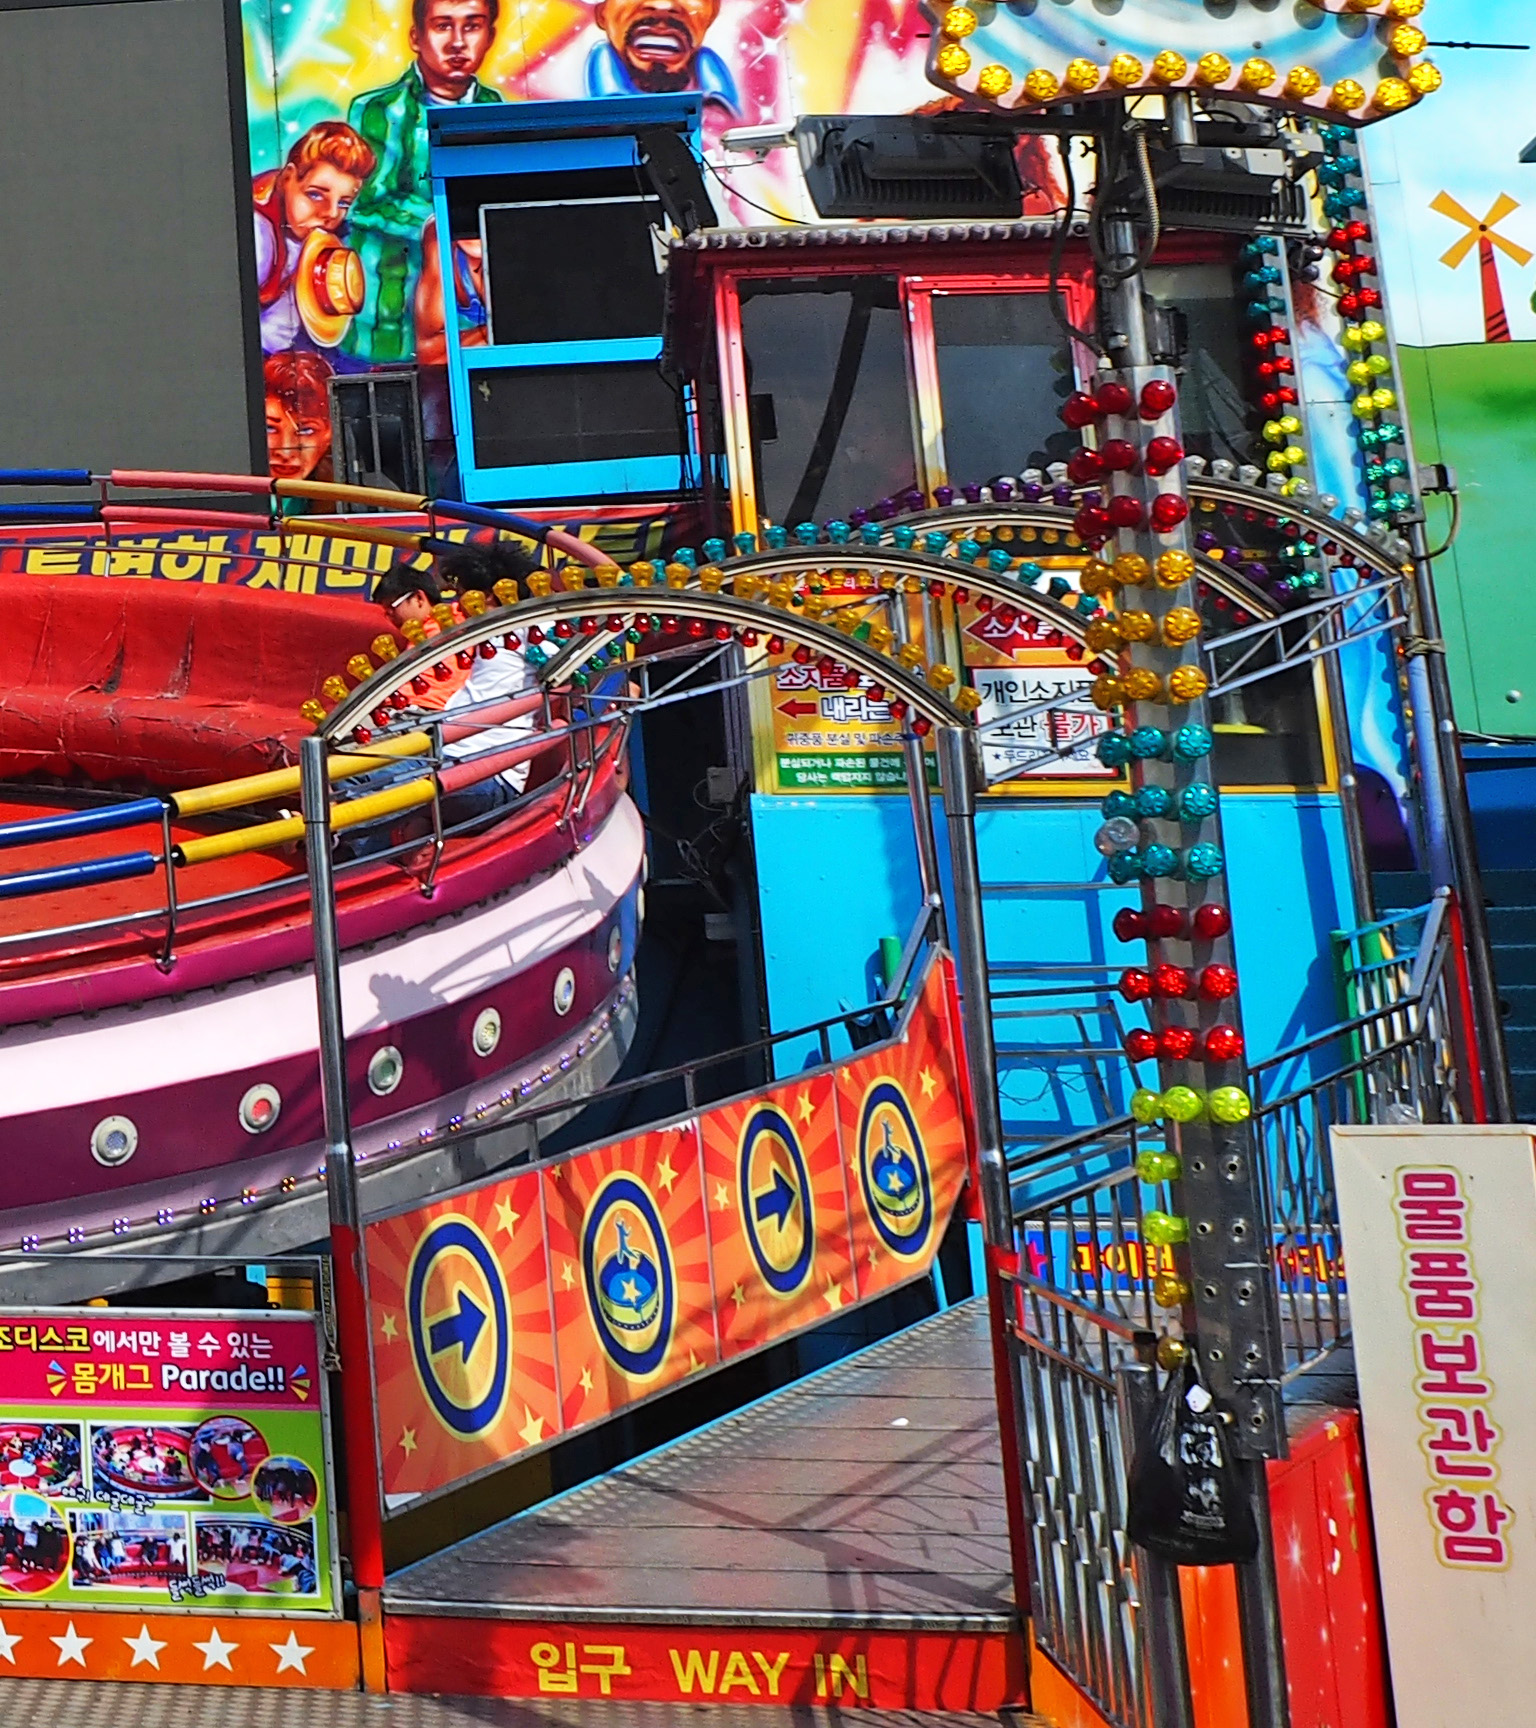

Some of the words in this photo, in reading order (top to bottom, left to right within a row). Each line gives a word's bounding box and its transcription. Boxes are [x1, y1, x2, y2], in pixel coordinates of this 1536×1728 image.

[169, 1331, 192, 1358] 볼
[197, 1334, 221, 1359] 수
[227, 1332, 273, 1359] 있는
[72, 1361, 153, 1394] 몸개그
[161, 1362, 286, 1393] Parade!!
[1397, 1171, 1508, 1566] 물품보관함
[530, 1642, 631, 1694] 입구
[669, 1648, 790, 1696] WAY
[814, 1652, 870, 1699] IN
